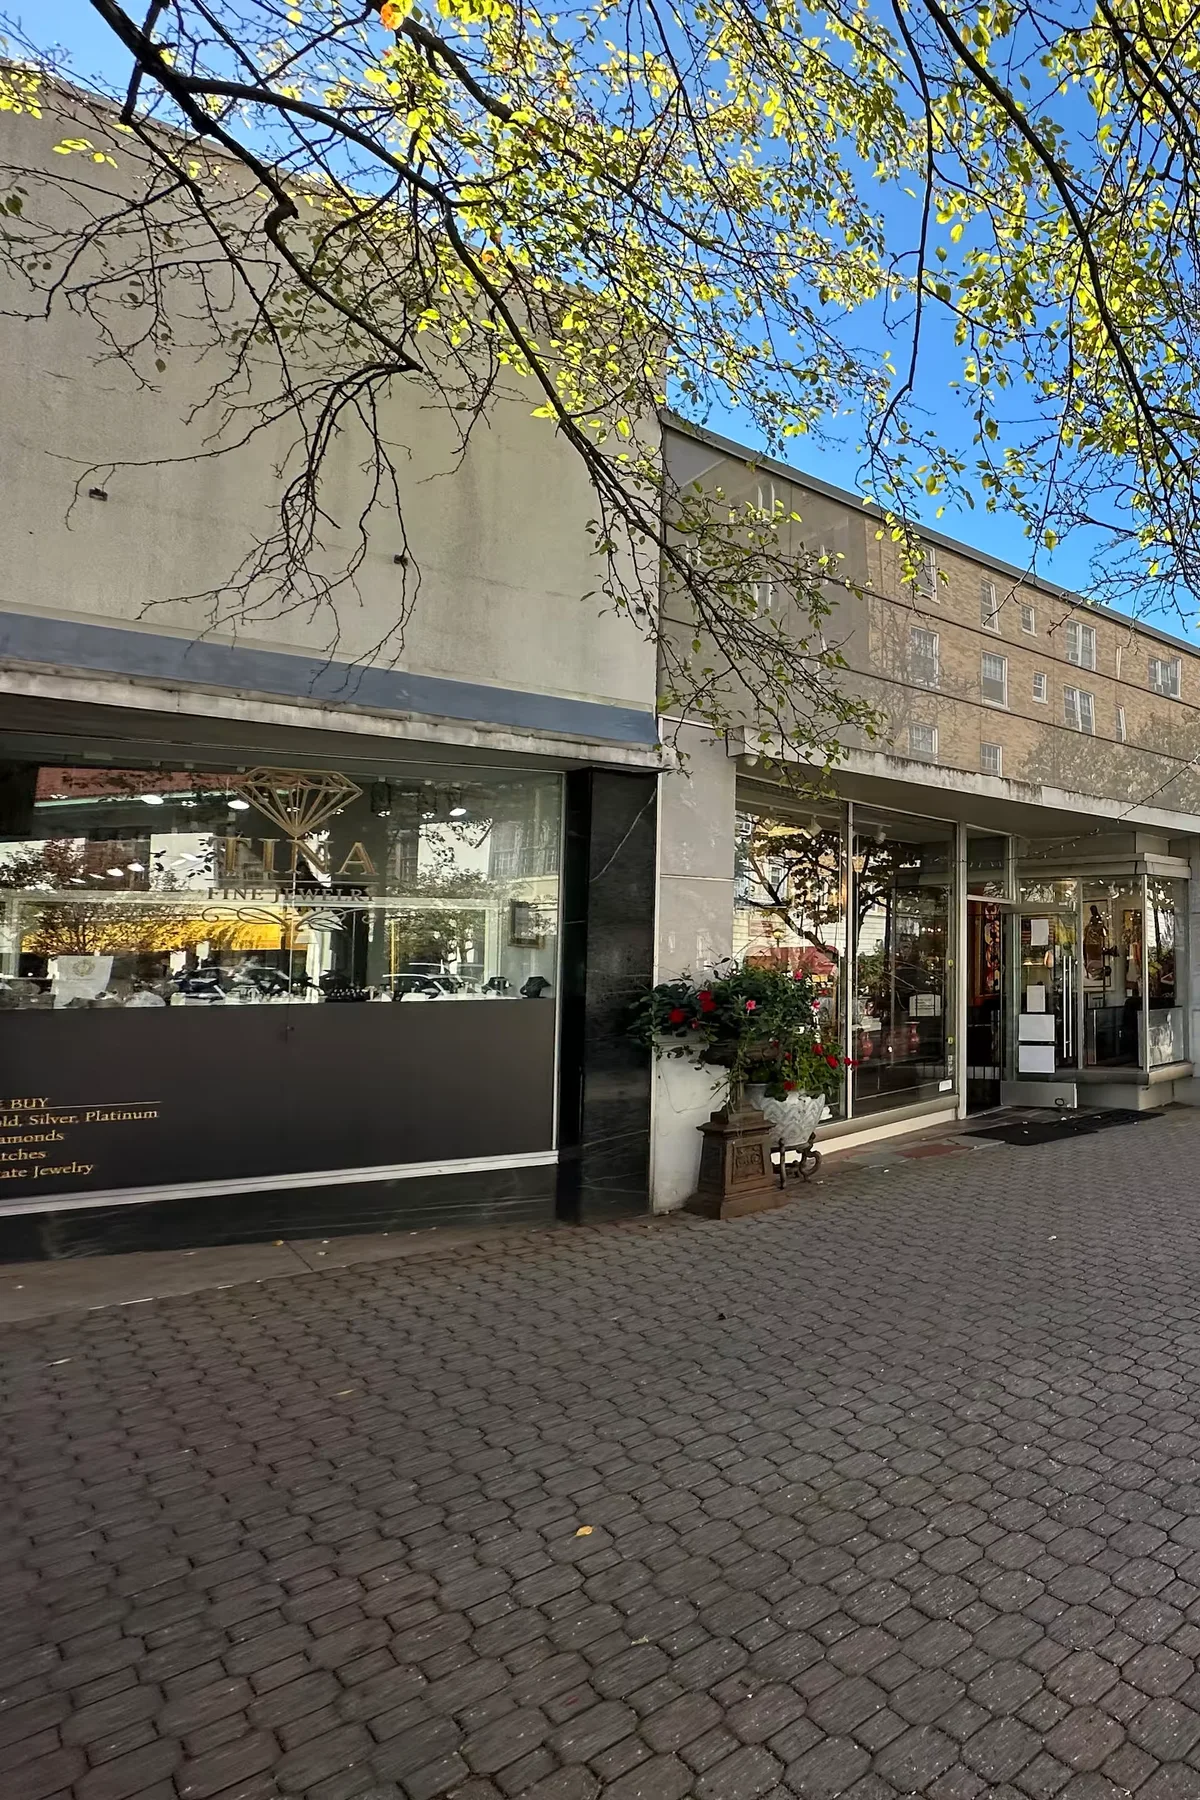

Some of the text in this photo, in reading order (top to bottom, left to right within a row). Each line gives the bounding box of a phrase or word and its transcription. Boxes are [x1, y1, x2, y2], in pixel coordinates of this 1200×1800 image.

[209, 836, 380, 876] TINA
[207, 886, 376, 903] FINE JEWELRY
[11, 1097, 49, 1109] BUY
[85, 1110, 158, 1123] Platinum
[33, 1161, 94, 1178] Jewelry
